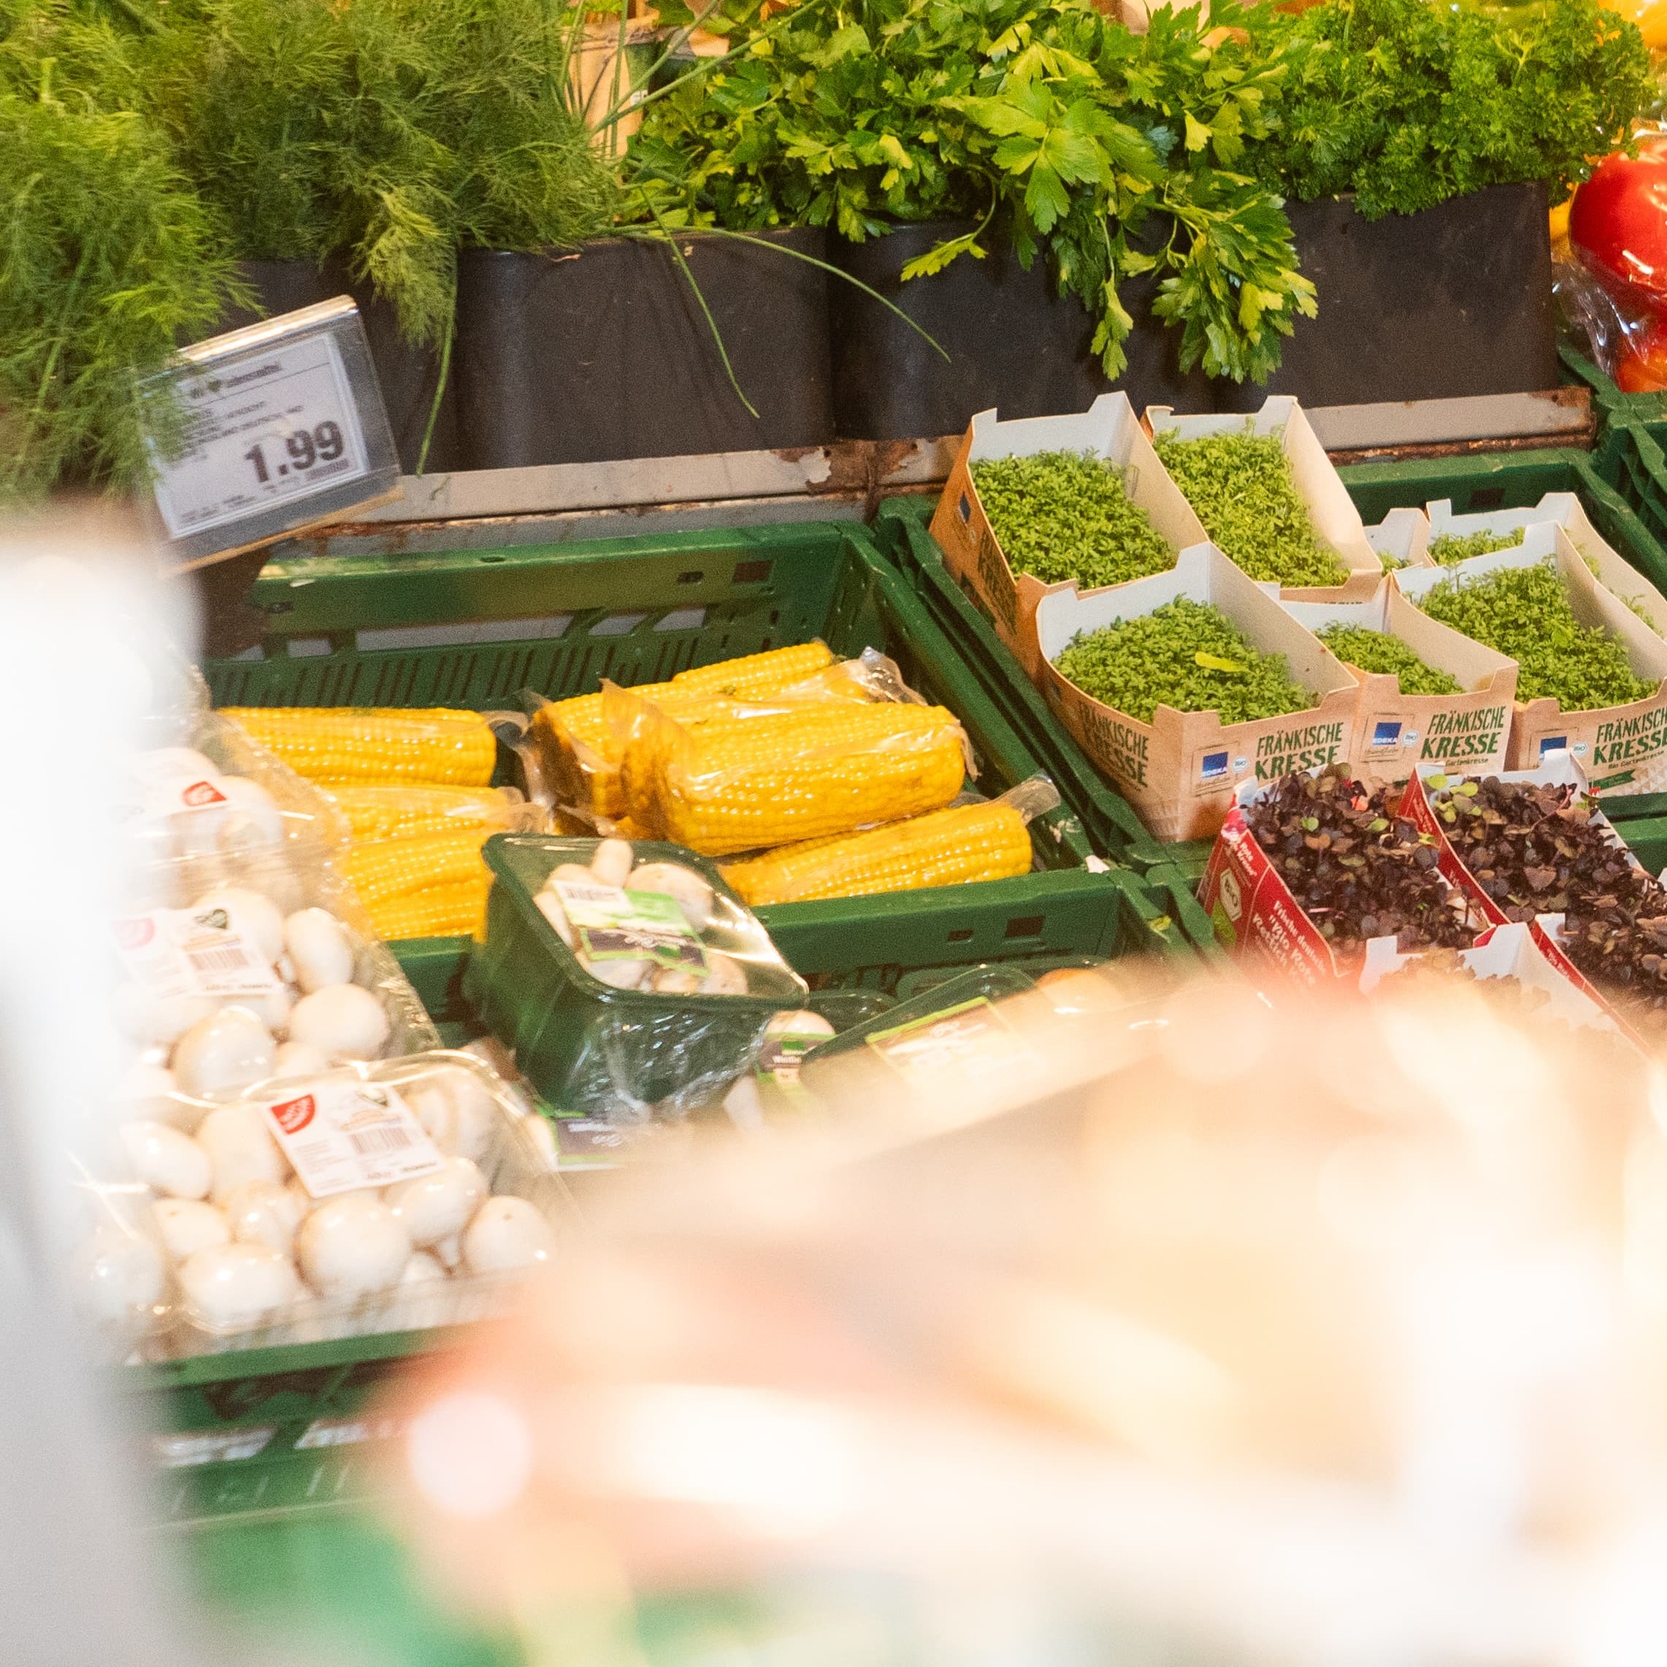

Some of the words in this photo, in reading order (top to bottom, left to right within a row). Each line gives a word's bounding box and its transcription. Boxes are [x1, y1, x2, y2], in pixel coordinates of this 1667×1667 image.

[243, 419, 344, 484] 1.99
[1427, 705, 1507, 736] FRÄNKISCHE
[1256, 722, 1344, 758] FRÄNKISCHE
[1420, 732, 1502, 760] KRESSE
